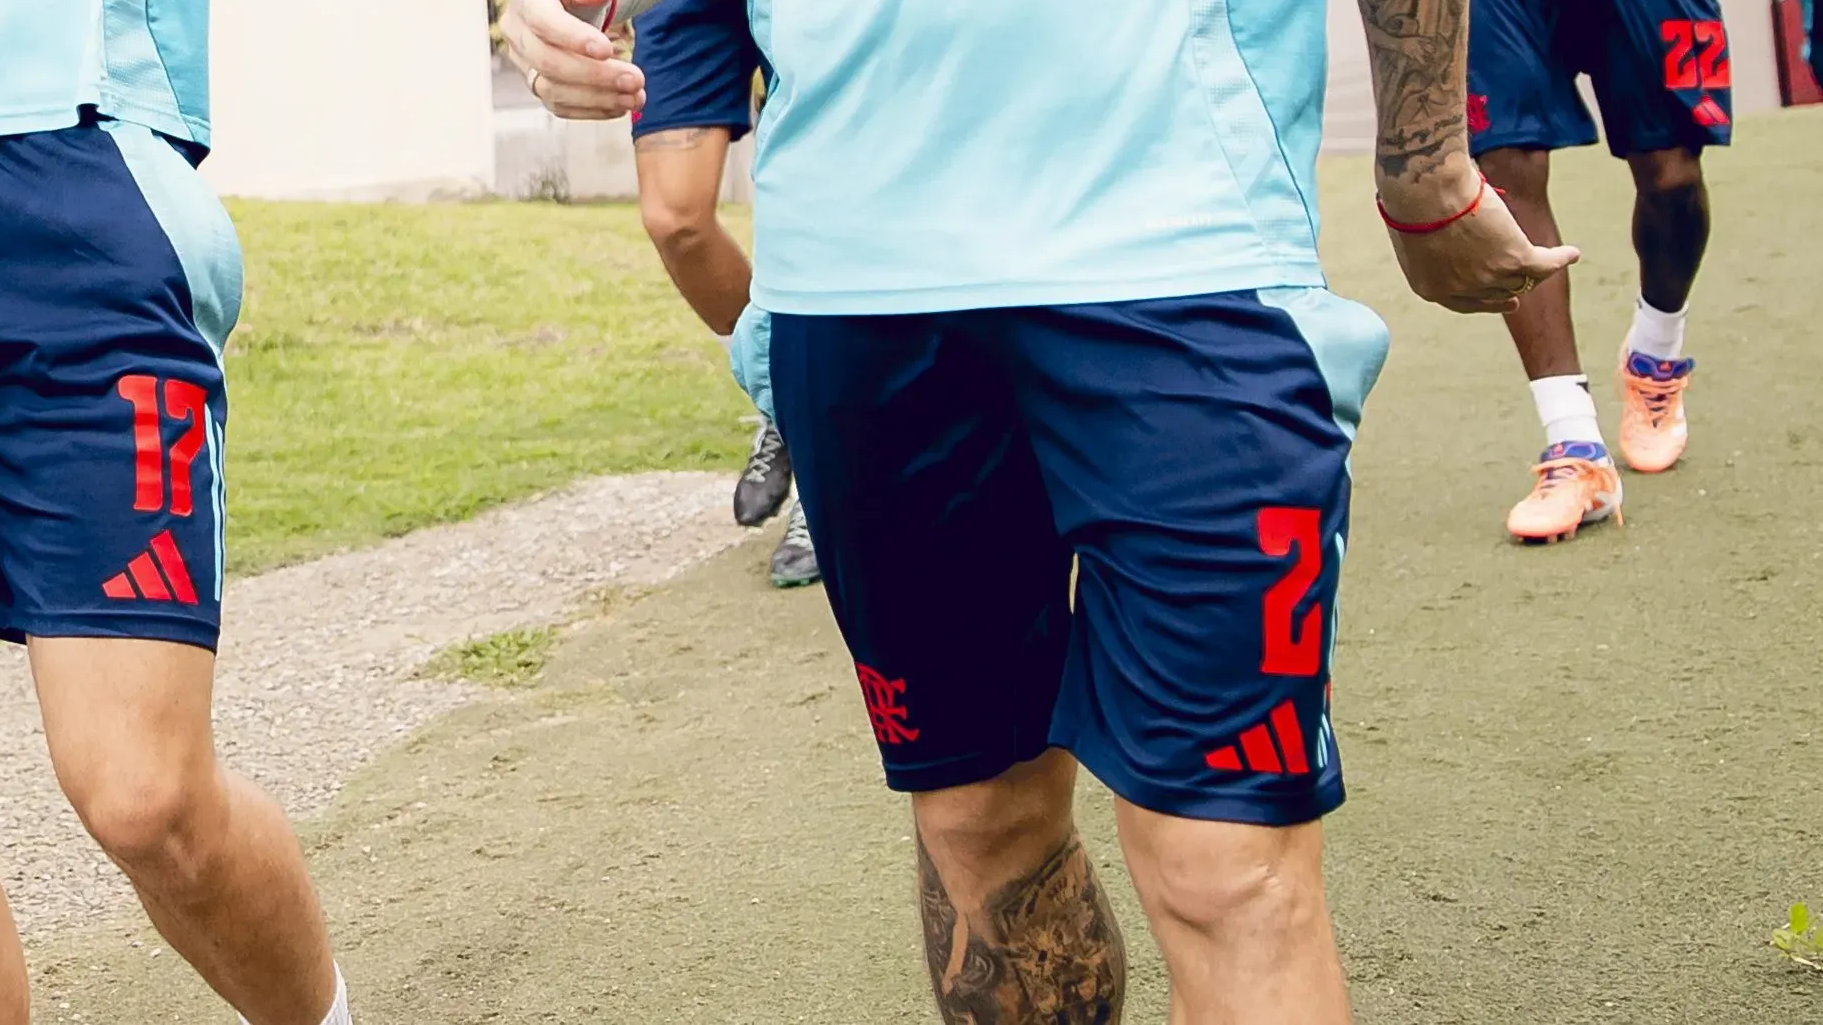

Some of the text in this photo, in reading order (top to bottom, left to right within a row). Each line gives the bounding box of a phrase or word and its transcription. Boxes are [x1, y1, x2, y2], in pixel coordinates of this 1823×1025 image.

[1661, 20, 1731, 90] 22
[117, 375, 208, 517] 17
[1257, 507, 1322, 675] 2
